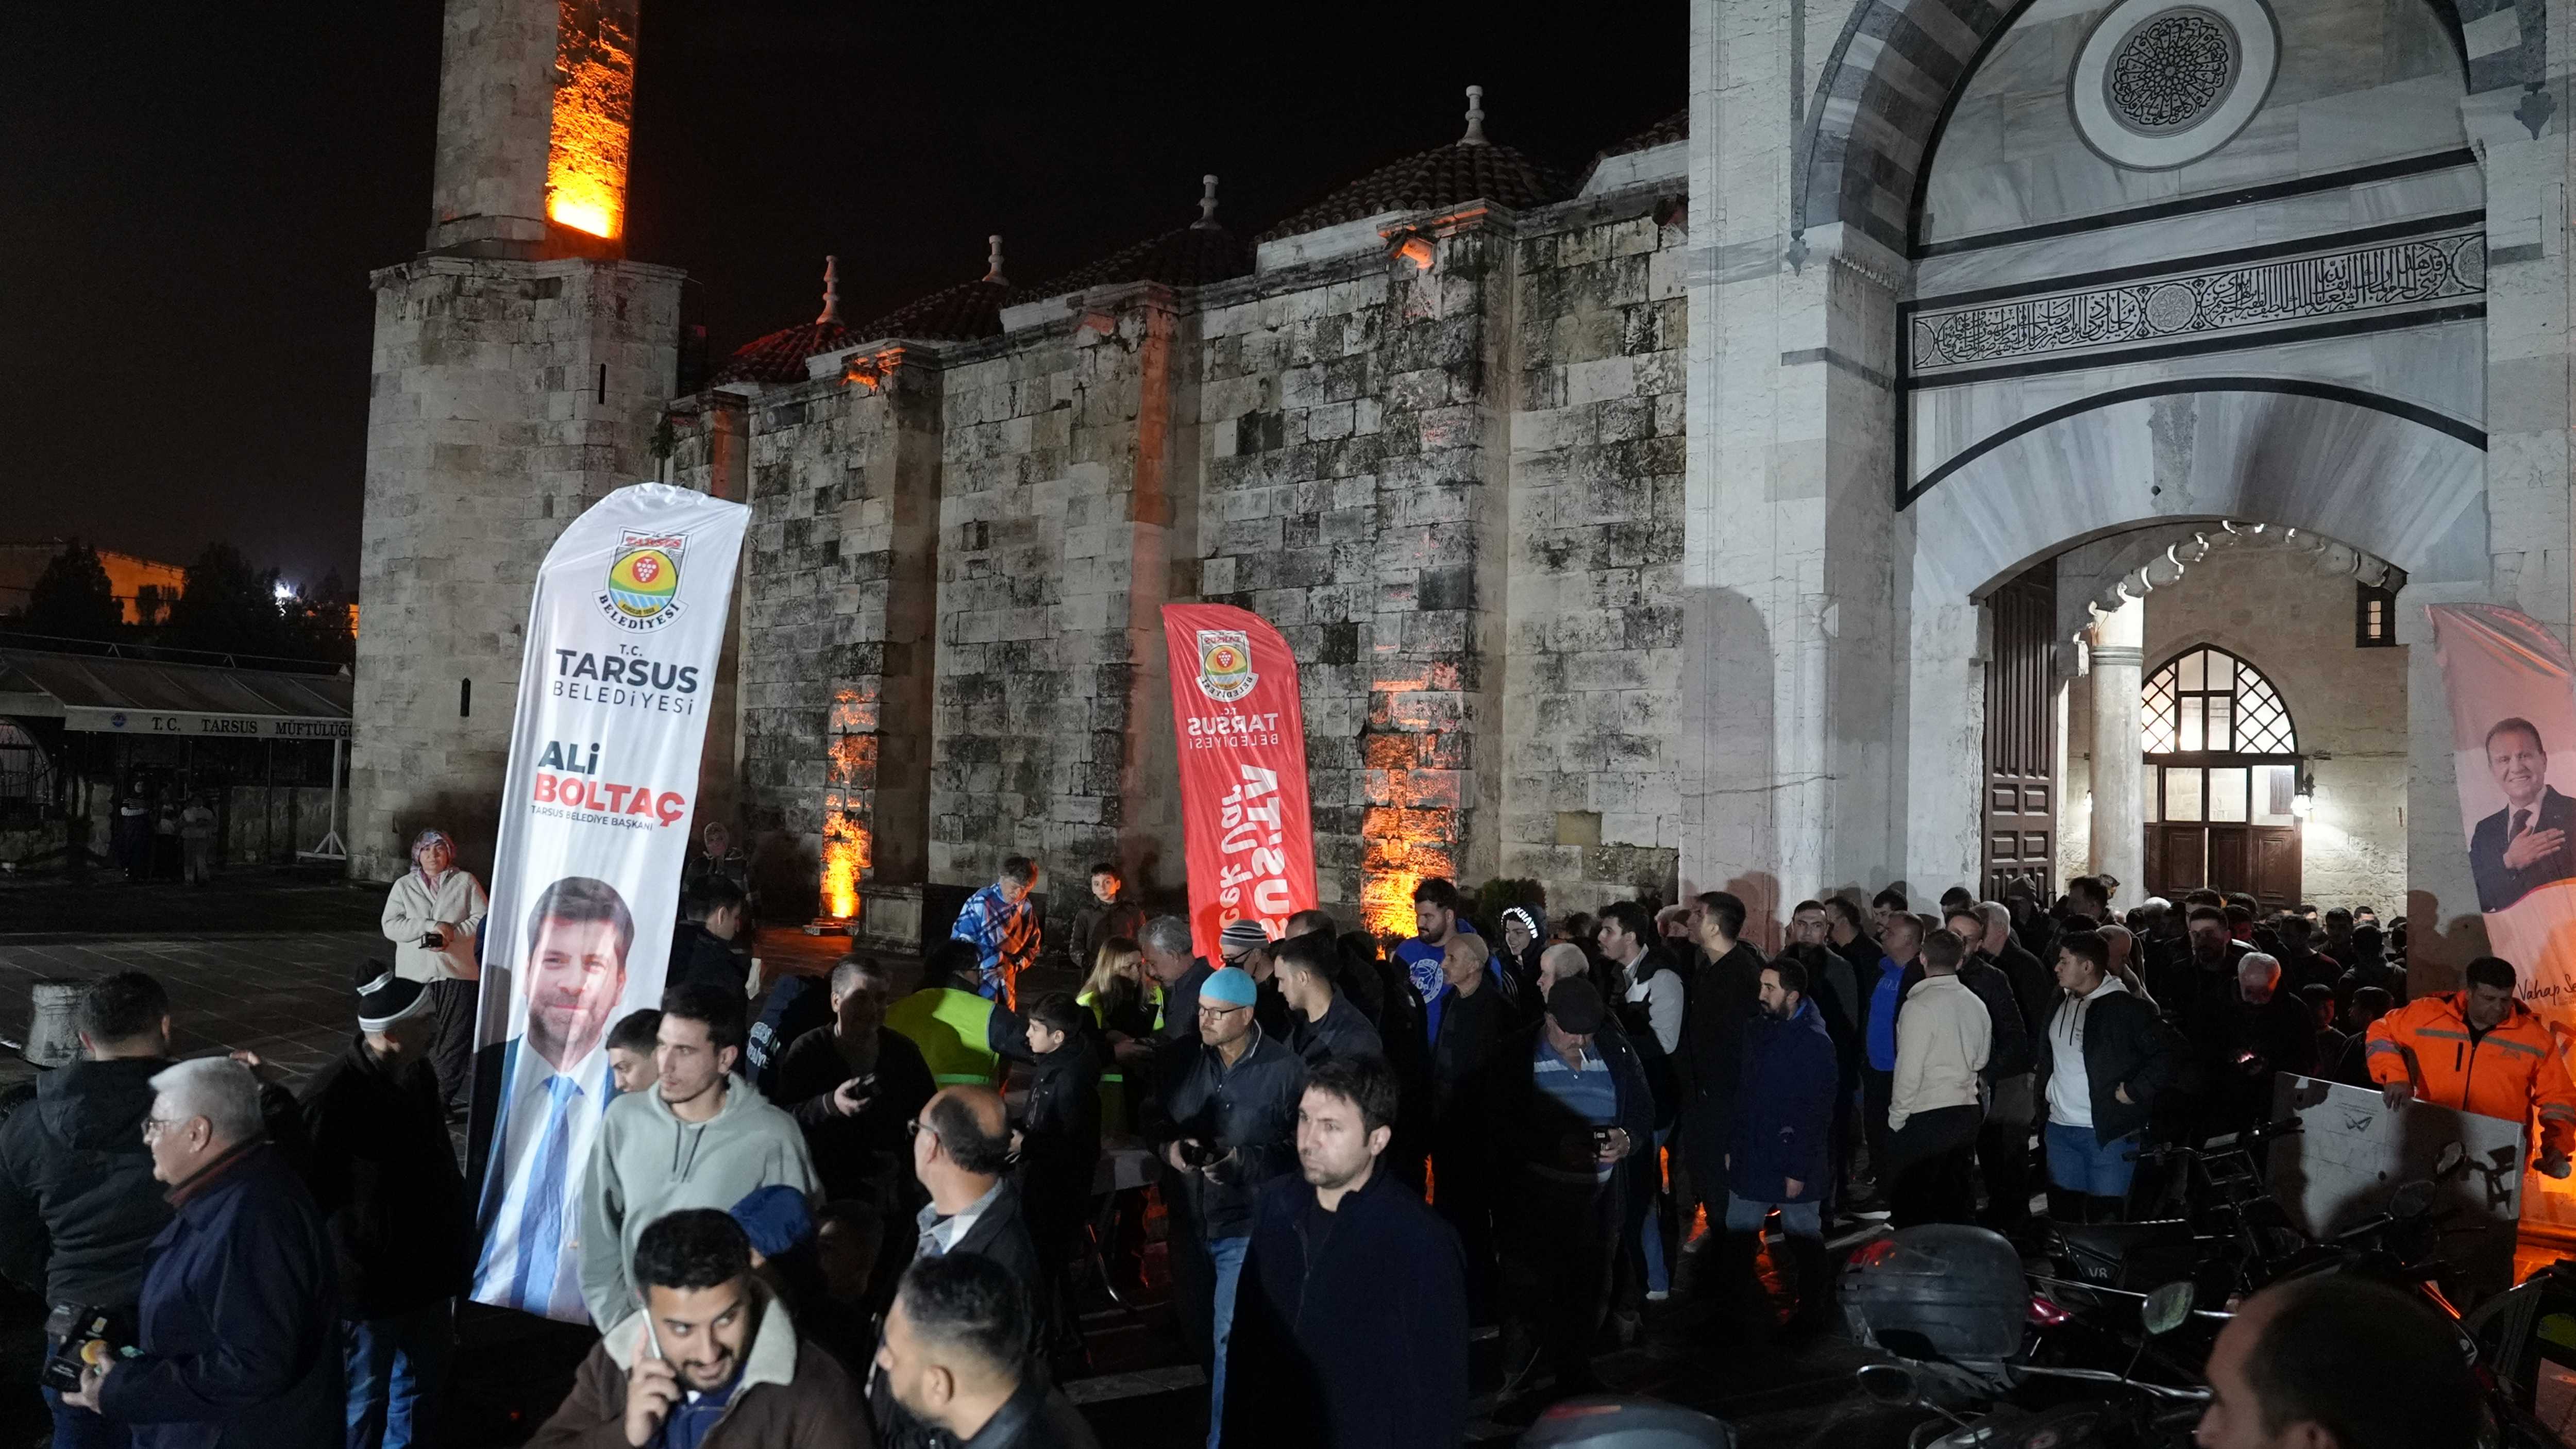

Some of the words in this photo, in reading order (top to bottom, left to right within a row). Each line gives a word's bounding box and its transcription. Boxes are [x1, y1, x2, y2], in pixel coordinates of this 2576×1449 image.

[620, 644, 643, 656] T.C.
[556, 648, 699, 694] TARSUS
[201, 719, 258, 734] TARSUS
[534, 772, 685, 827] BOLTAÇ
[531, 805, 564, 818] TARSUS
[611, 817, 653, 831] BAŞKANI
[2518, 979, 2561, 1006] Vahap
